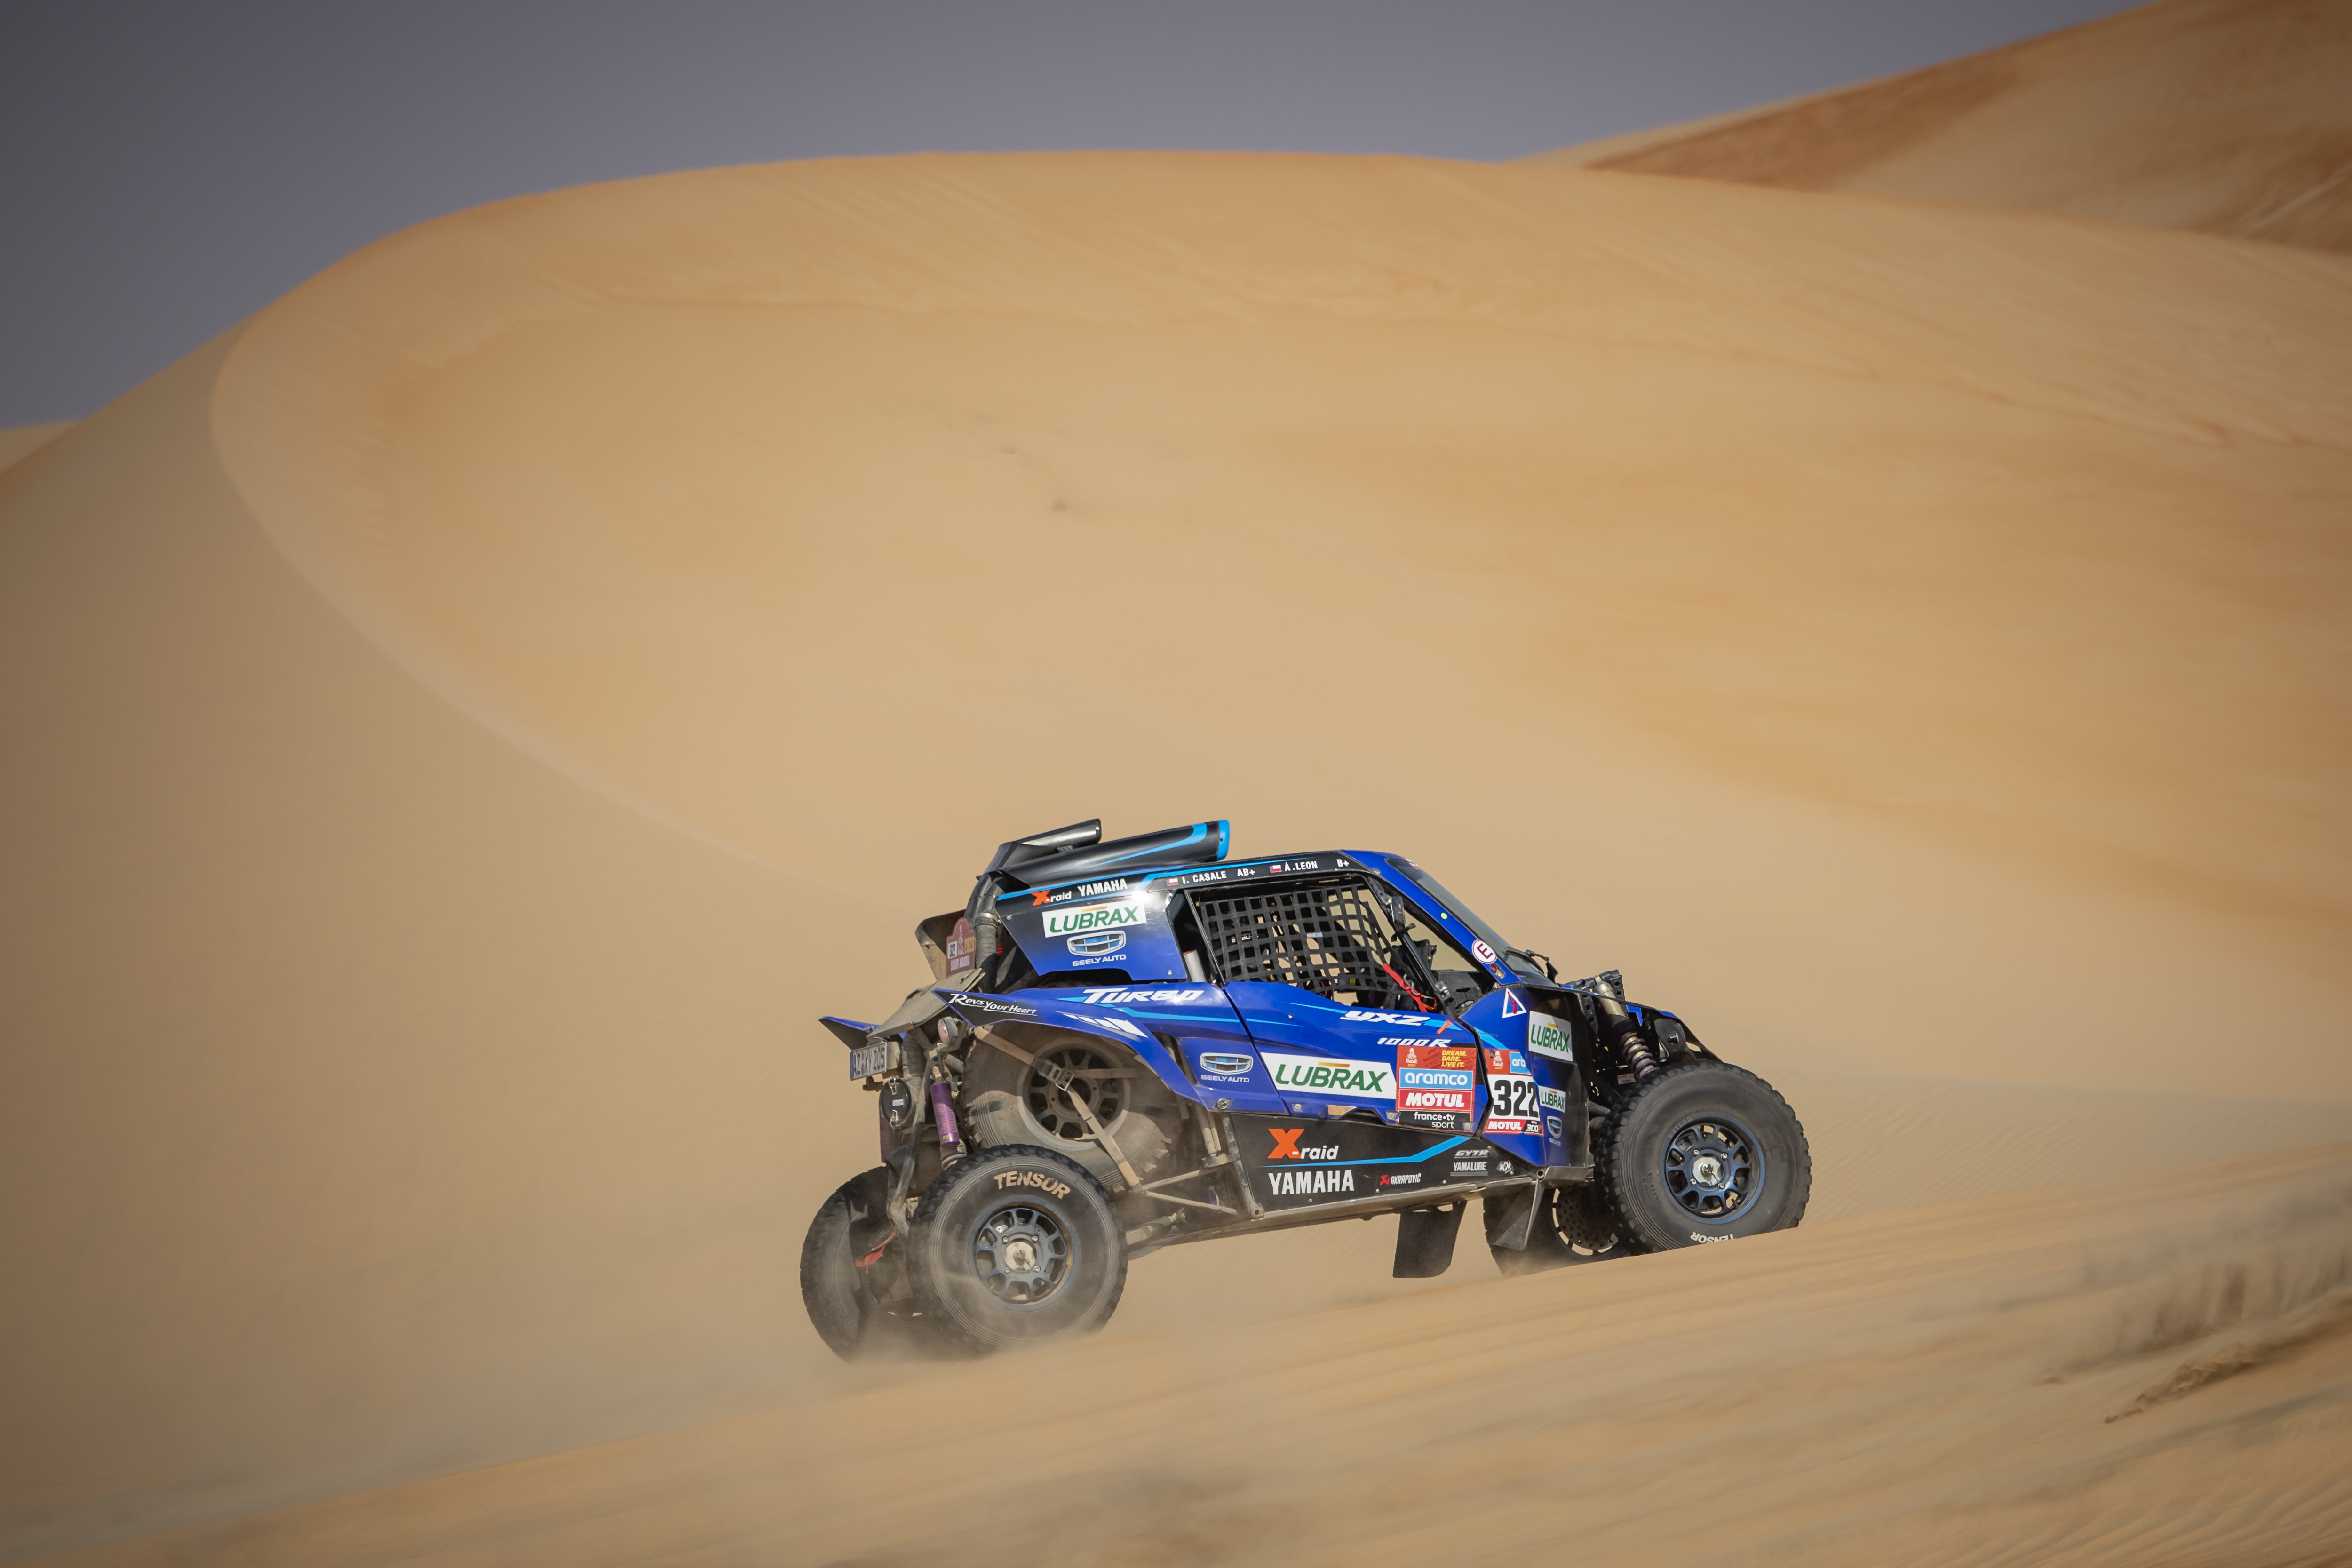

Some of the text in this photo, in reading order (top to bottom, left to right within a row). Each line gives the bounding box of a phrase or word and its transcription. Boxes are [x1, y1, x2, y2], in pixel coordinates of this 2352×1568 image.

[1192, 871, 1227, 883] CASALE
[1237, 868, 1255, 877] AB+
[1337, 859, 1350, 868] B+
[1031, 878, 1128, 906] X-raid YAMAHA
[1049, 906, 1140, 933] LUBRAX
[1072, 954, 1127, 967] GEELY AUTO
[1476, 943, 1493, 960] E
[983, 1001, 1010, 1012] Your
[1009, 1004, 1038, 1015] Heart
[1340, 1011, 1430, 1026] YXZ
[1530, 1024, 1570, 1053] LUBRAX
[1275, 1064, 1388, 1092] LUBRAX
[1404, 1072, 1468, 1086] aramco
[1405, 1092, 1465, 1108] MOTUL
[1493, 1079, 1539, 1119] 322
[1541, 1090, 1565, 1111] LUBRAX
[1431, 1121, 1454, 1130] sport
[1487, 1120, 1522, 1130] MOTUL
[1267, 1129, 1340, 1160] X-raid
[1453, 1162, 1486, 1171] YAMALUBE
[993, 1170, 1071, 1200] TENSOR
[1268, 1170, 1355, 1195] YAMAHA
